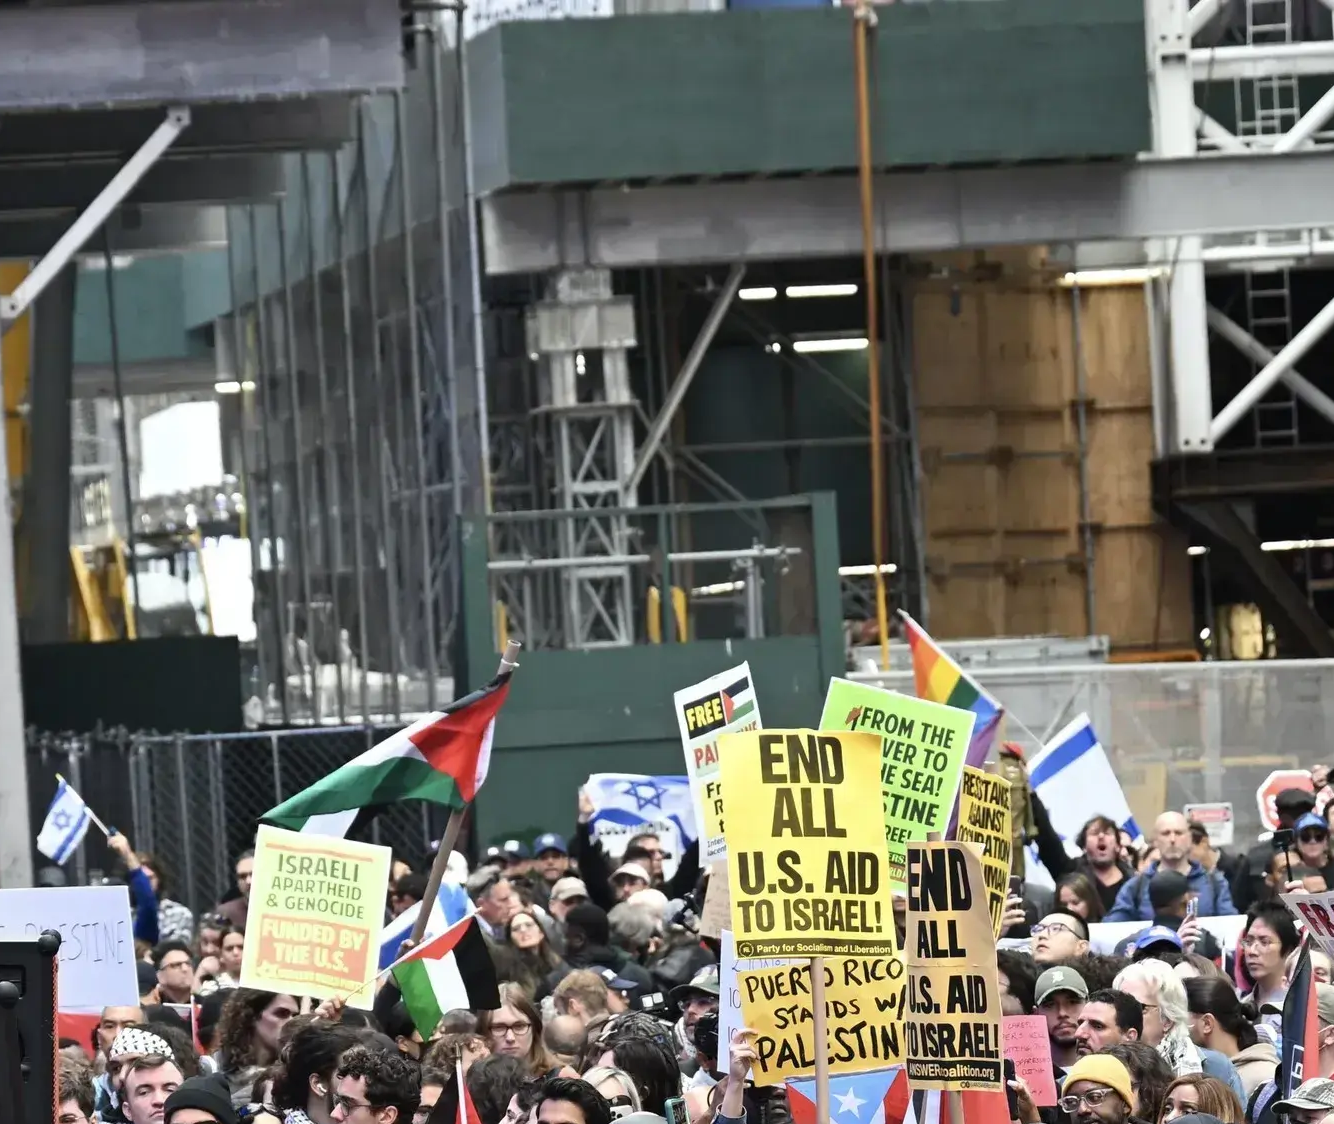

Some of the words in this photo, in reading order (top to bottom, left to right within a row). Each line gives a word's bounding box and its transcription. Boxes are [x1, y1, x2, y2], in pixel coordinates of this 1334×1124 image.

[685, 697, 724, 731] FREE
[860, 706, 916, 740] FROM
[920, 722, 956, 750] THE
[758, 734, 845, 785] END
[882, 737, 919, 766] VER
[923, 748, 948, 773] TO
[881, 764, 897, 786] HE
[901, 769, 944, 798] SEA!
[771, 787, 848, 839] ALL
[881, 790, 940, 828] STINE
[885, 823, 913, 845] REE!
[278, 853, 359, 883] ISRAELI
[737, 849, 815, 895] U.S.
[825, 850, 880, 895] AID
[908, 848, 972, 912] END
[271, 876, 362, 901] APARTHEID
[266, 893, 279, 908] &
[285, 896, 365, 920] GENOCIDE
[737, 898, 775, 933] TO
[783, 898, 883, 933] ISRAEL!
[261, 918, 336, 945] FUNDED
[339, 928, 366, 951] BY
[756, 944, 780, 954] Party
[782, 943, 795, 952] for
[797, 943, 833, 953] Socialism
[834, 945, 849, 953] and
[850, 944, 891, 954] Liberation
[917, 919, 967, 959] ALL
[273, 941, 311, 966] THE
[312, 948, 350, 974] U.S.
[842, 958, 904, 987] RICO
[908, 975, 941, 1015] U.S.
[947, 974, 988, 1015] AID
[774, 998, 861, 1030] STADS
[906, 1023, 918, 1059] TO
[921, 1022, 999, 1060] ISRAEL!
